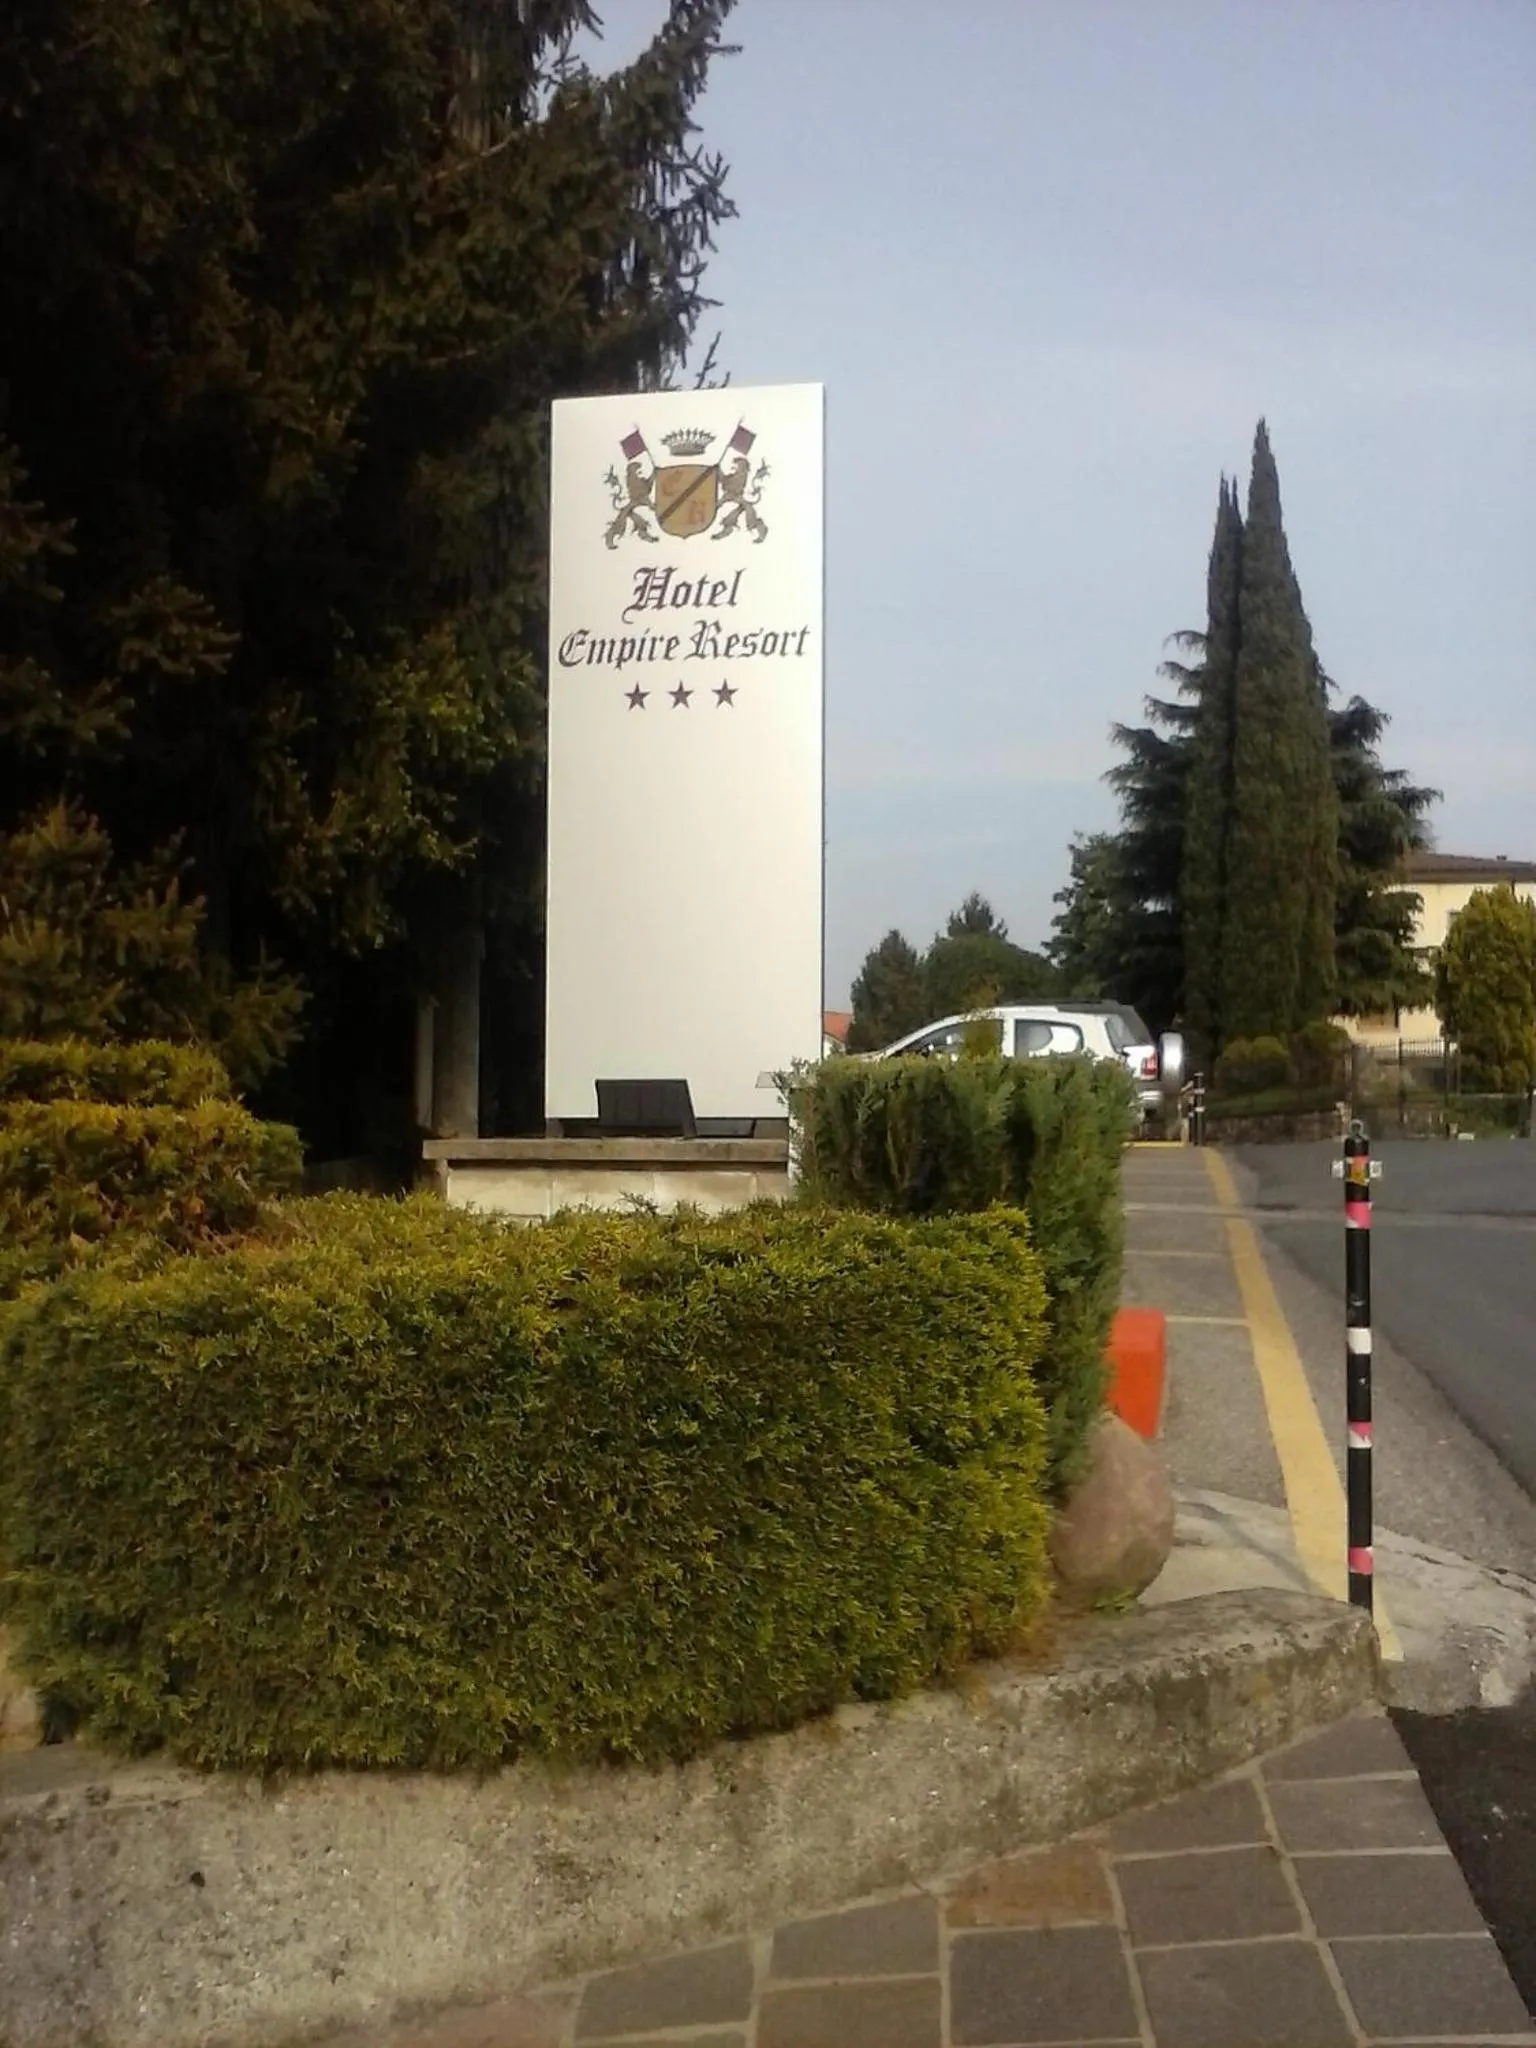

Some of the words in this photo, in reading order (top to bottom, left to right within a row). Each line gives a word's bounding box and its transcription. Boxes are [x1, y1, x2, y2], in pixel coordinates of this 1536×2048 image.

[621, 566, 746, 624] Hotel
[557, 628, 680, 670] Empire
[684, 619, 810, 661] Resort
